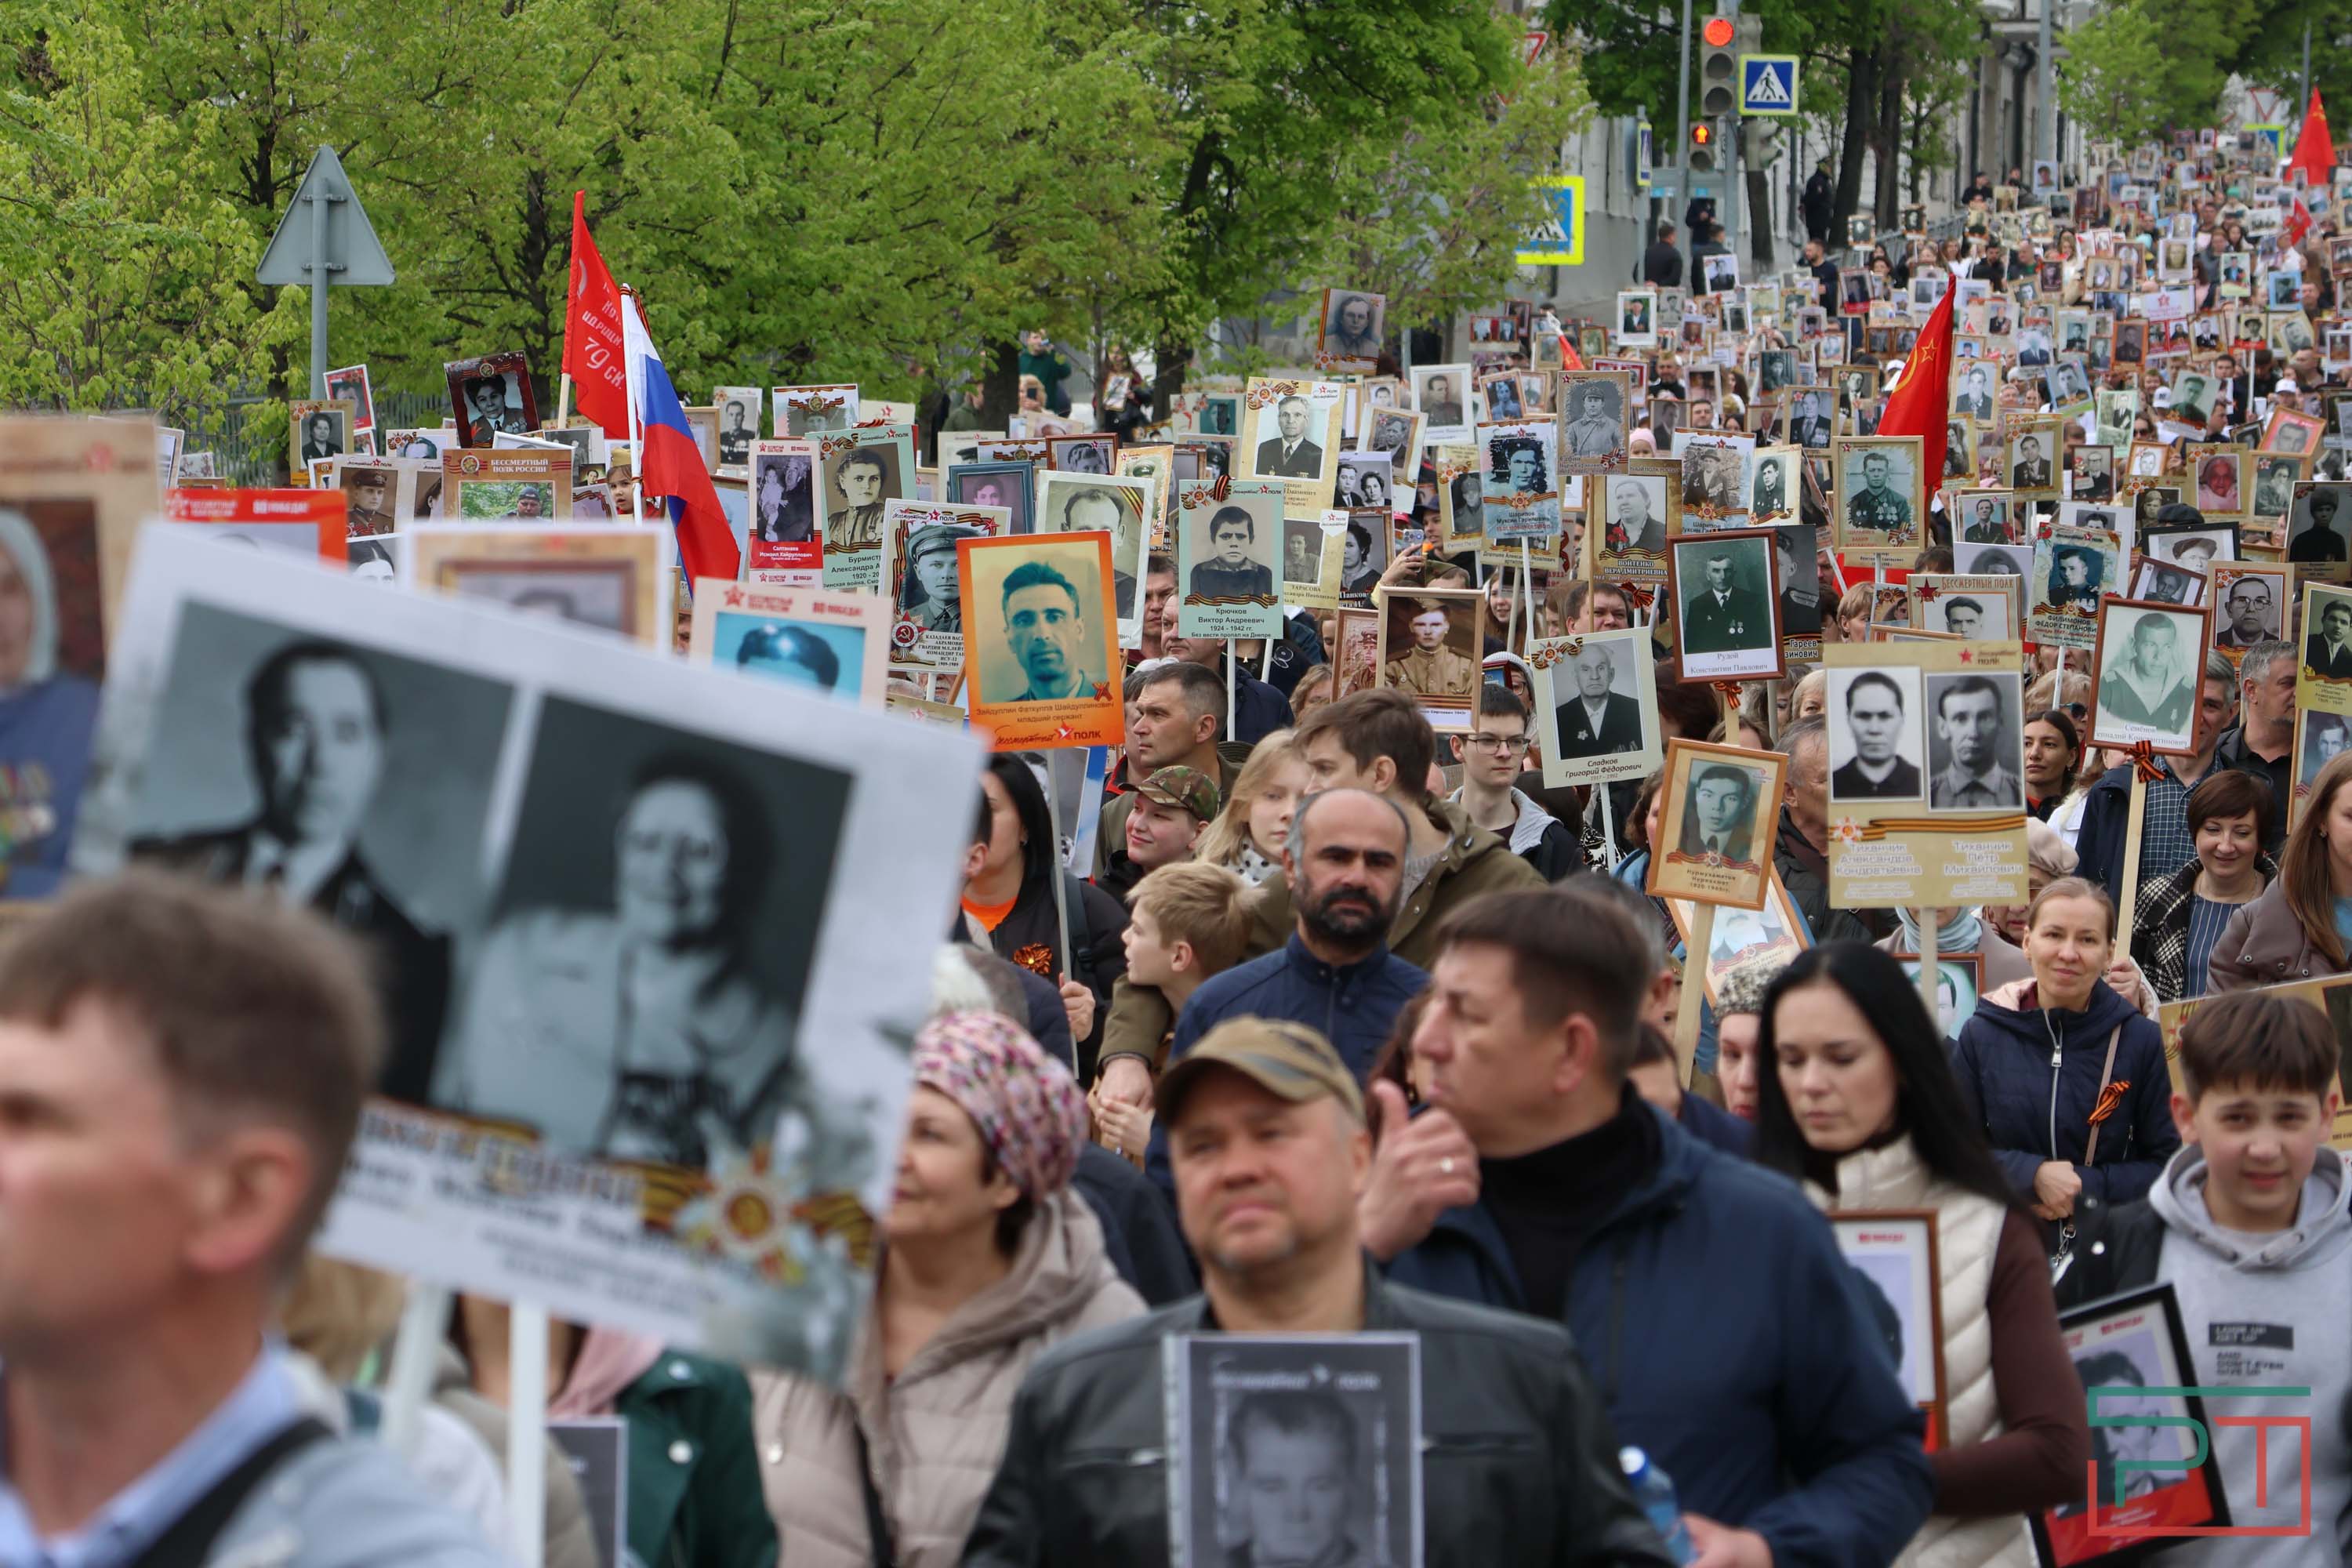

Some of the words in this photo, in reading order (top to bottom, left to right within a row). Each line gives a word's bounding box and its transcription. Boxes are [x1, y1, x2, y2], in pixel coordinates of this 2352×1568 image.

[584, 336, 611, 370] 79
[491, 458, 549, 466] БЕССМЕРТНЫЙ
[1617, 558, 1655, 568] ВОЙТЕНКО
[831, 564, 874, 574] Александра
[1621, 568, 1668, 576] ДМИТРИЕВНА
[1994, 578, 2014, 589] ПОЛК
[1789, 638, 1818, 648] Гареев
[1717, 652, 1739, 661] Рудой
[1784, 651, 1819, 659] зинович
[1690, 665, 1732, 675] Константин
[1017, 714, 1051, 724] младший
[1052, 713, 1083, 722] сержант
[1587, 758, 1618, 768] Сладков
[1565, 767, 1600, 779] Григорий
[1601, 764, 1642, 773] Фёдорович
